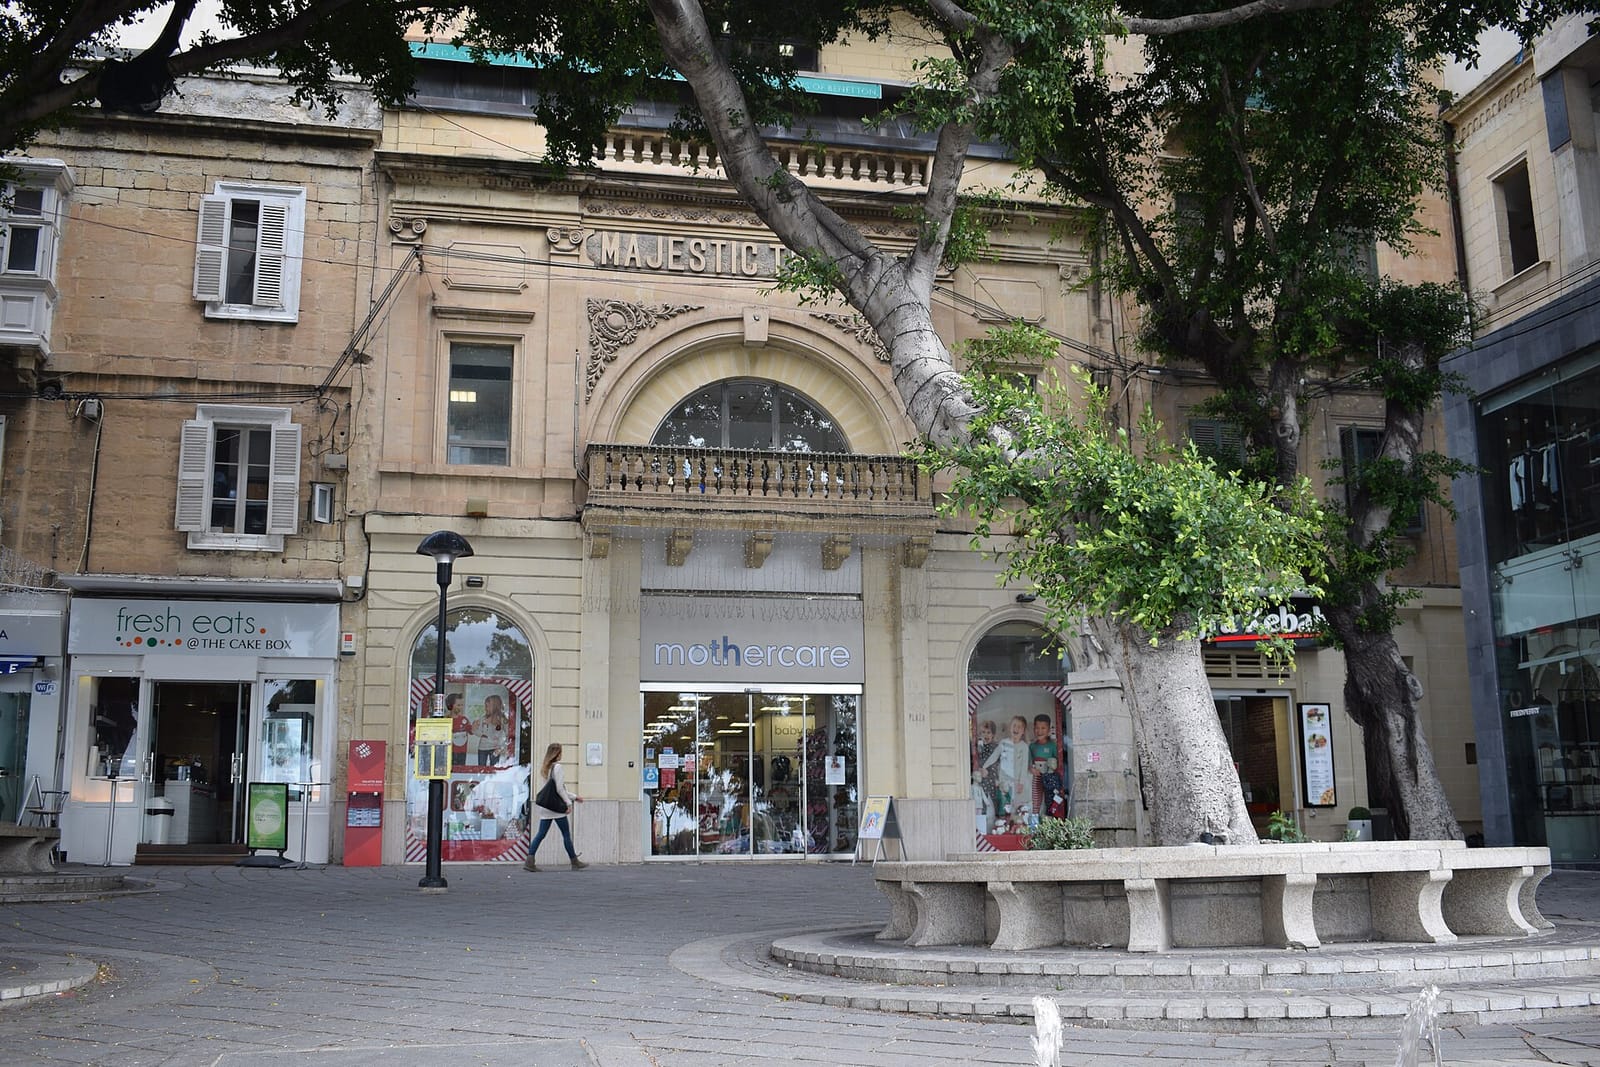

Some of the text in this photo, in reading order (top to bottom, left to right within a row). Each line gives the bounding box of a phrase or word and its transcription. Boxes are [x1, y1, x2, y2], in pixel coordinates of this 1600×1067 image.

[827, 84, 877, 96] BENETTON
[601, 231, 758, 276] MAJESTIC
[116, 606, 181, 633] fresh
[187, 637, 292, 650] @ THE CAKE BOX
[654, 635, 851, 668] mothercare
